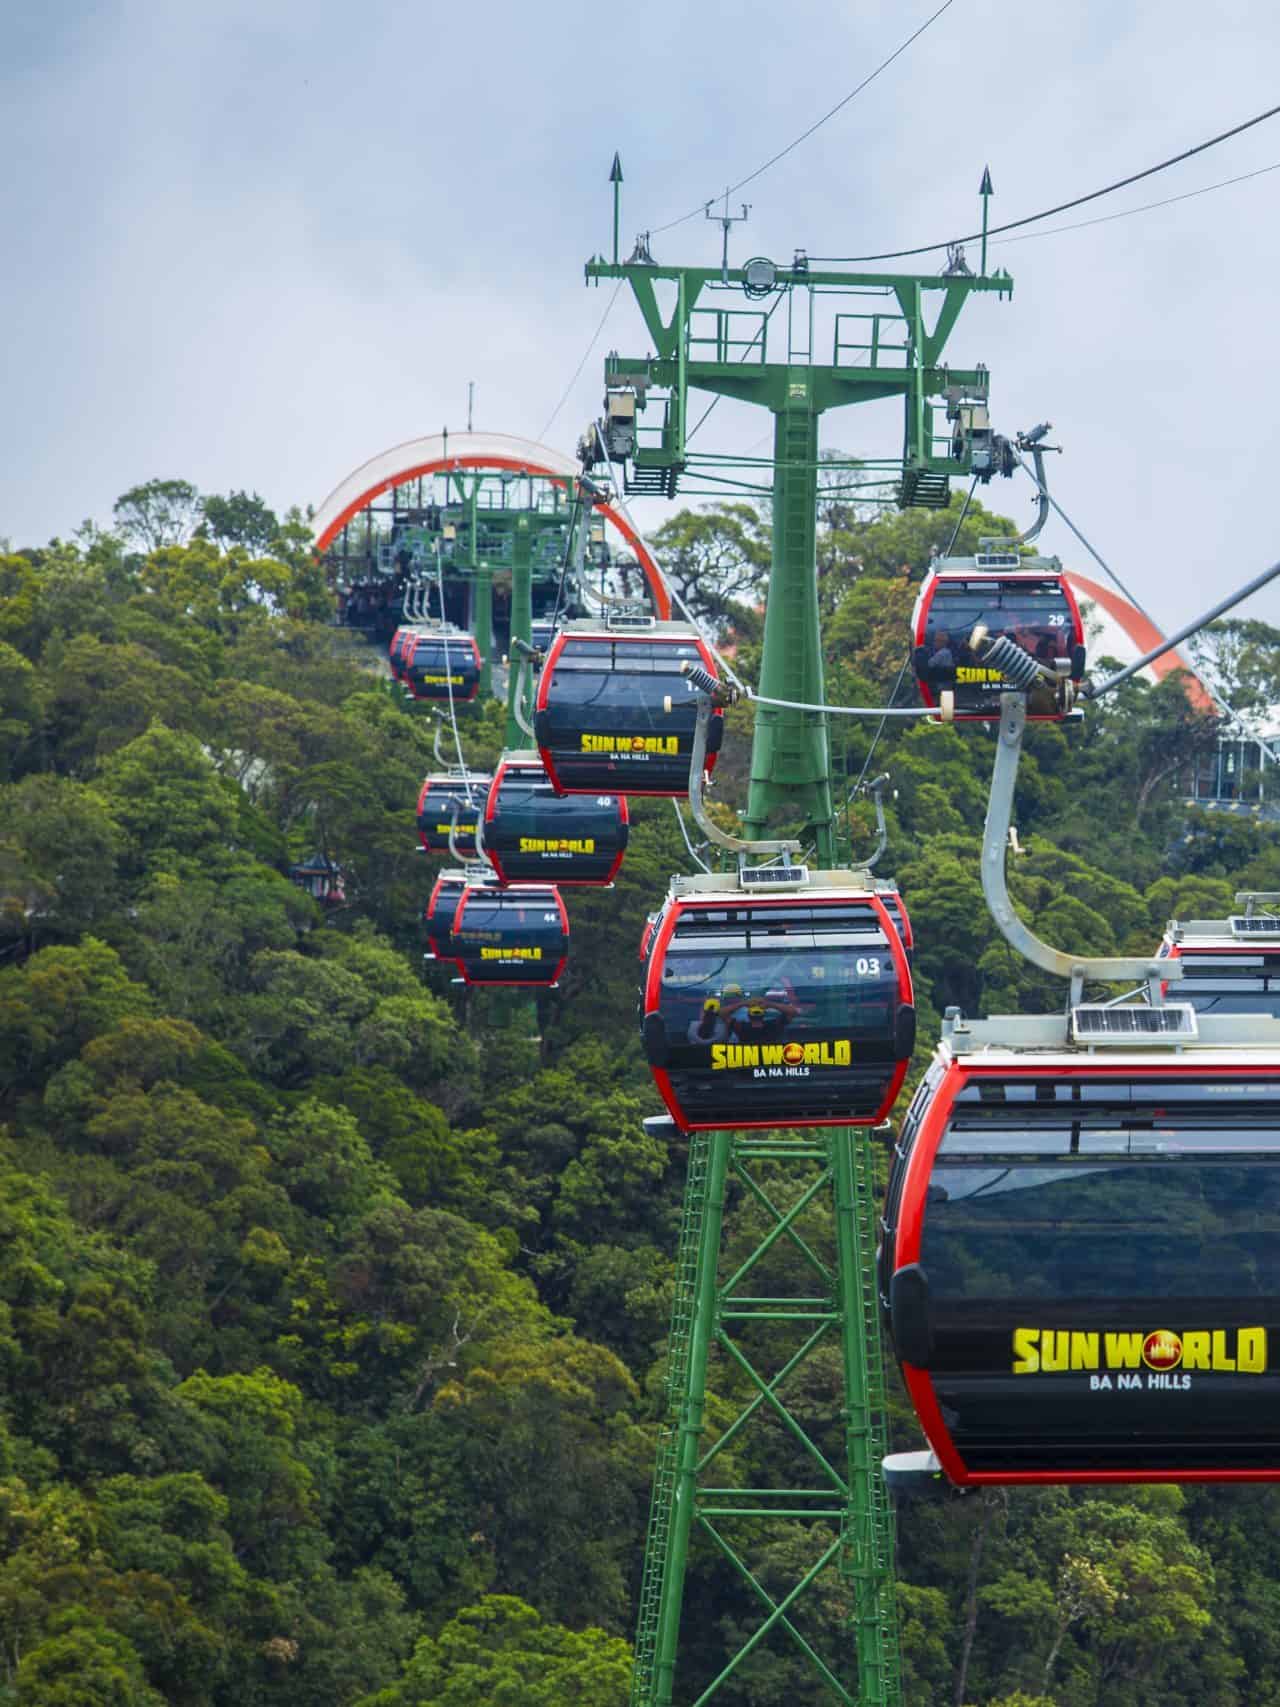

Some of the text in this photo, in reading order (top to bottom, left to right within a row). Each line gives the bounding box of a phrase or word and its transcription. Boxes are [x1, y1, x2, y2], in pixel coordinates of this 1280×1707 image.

[1048, 614, 1065, 626] 29
[956, 667, 986, 683] SUN
[685, 680, 700, 692] 1
[855, 957, 881, 976] 03
[712, 1039, 851, 1070] SUN WORLD
[753, 1066, 810, 1079] BA NA HILLS
[1012, 1326, 1268, 1374] SUN WORLD
[1089, 1374, 1192, 1390] BA NA HILLS
